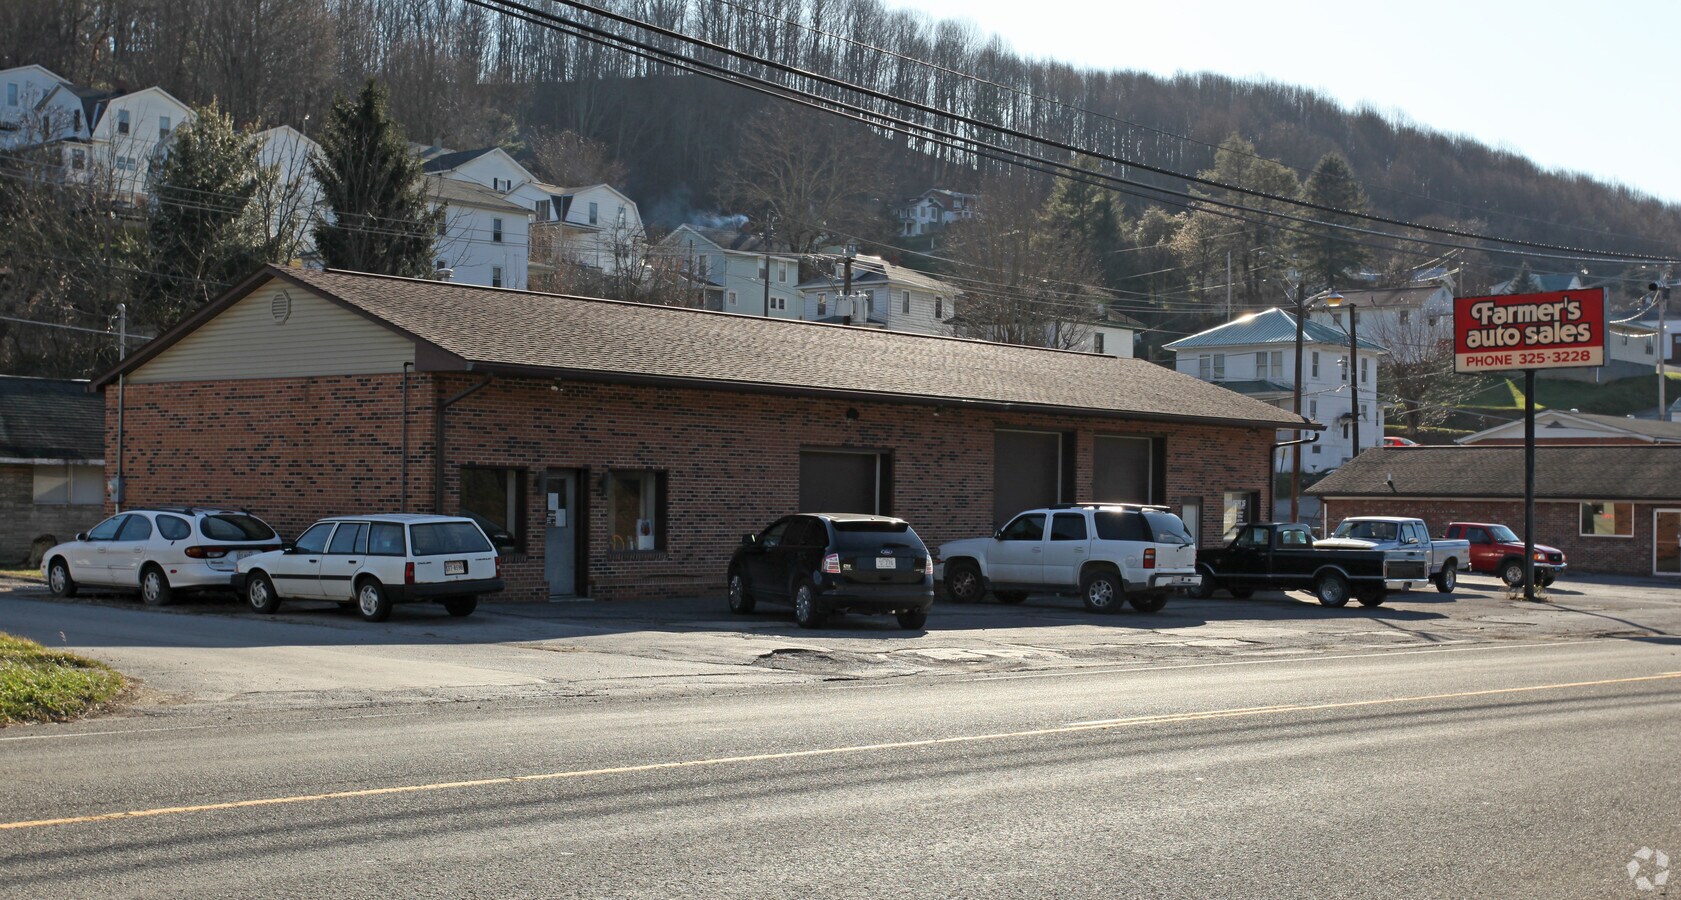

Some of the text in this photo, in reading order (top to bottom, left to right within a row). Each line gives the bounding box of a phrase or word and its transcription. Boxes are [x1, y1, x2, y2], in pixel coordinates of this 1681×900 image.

[1471, 296, 1581, 326] Farmer's
[1466, 321, 1591, 348] auto sales
[1466, 354, 1512, 367] PHONE
